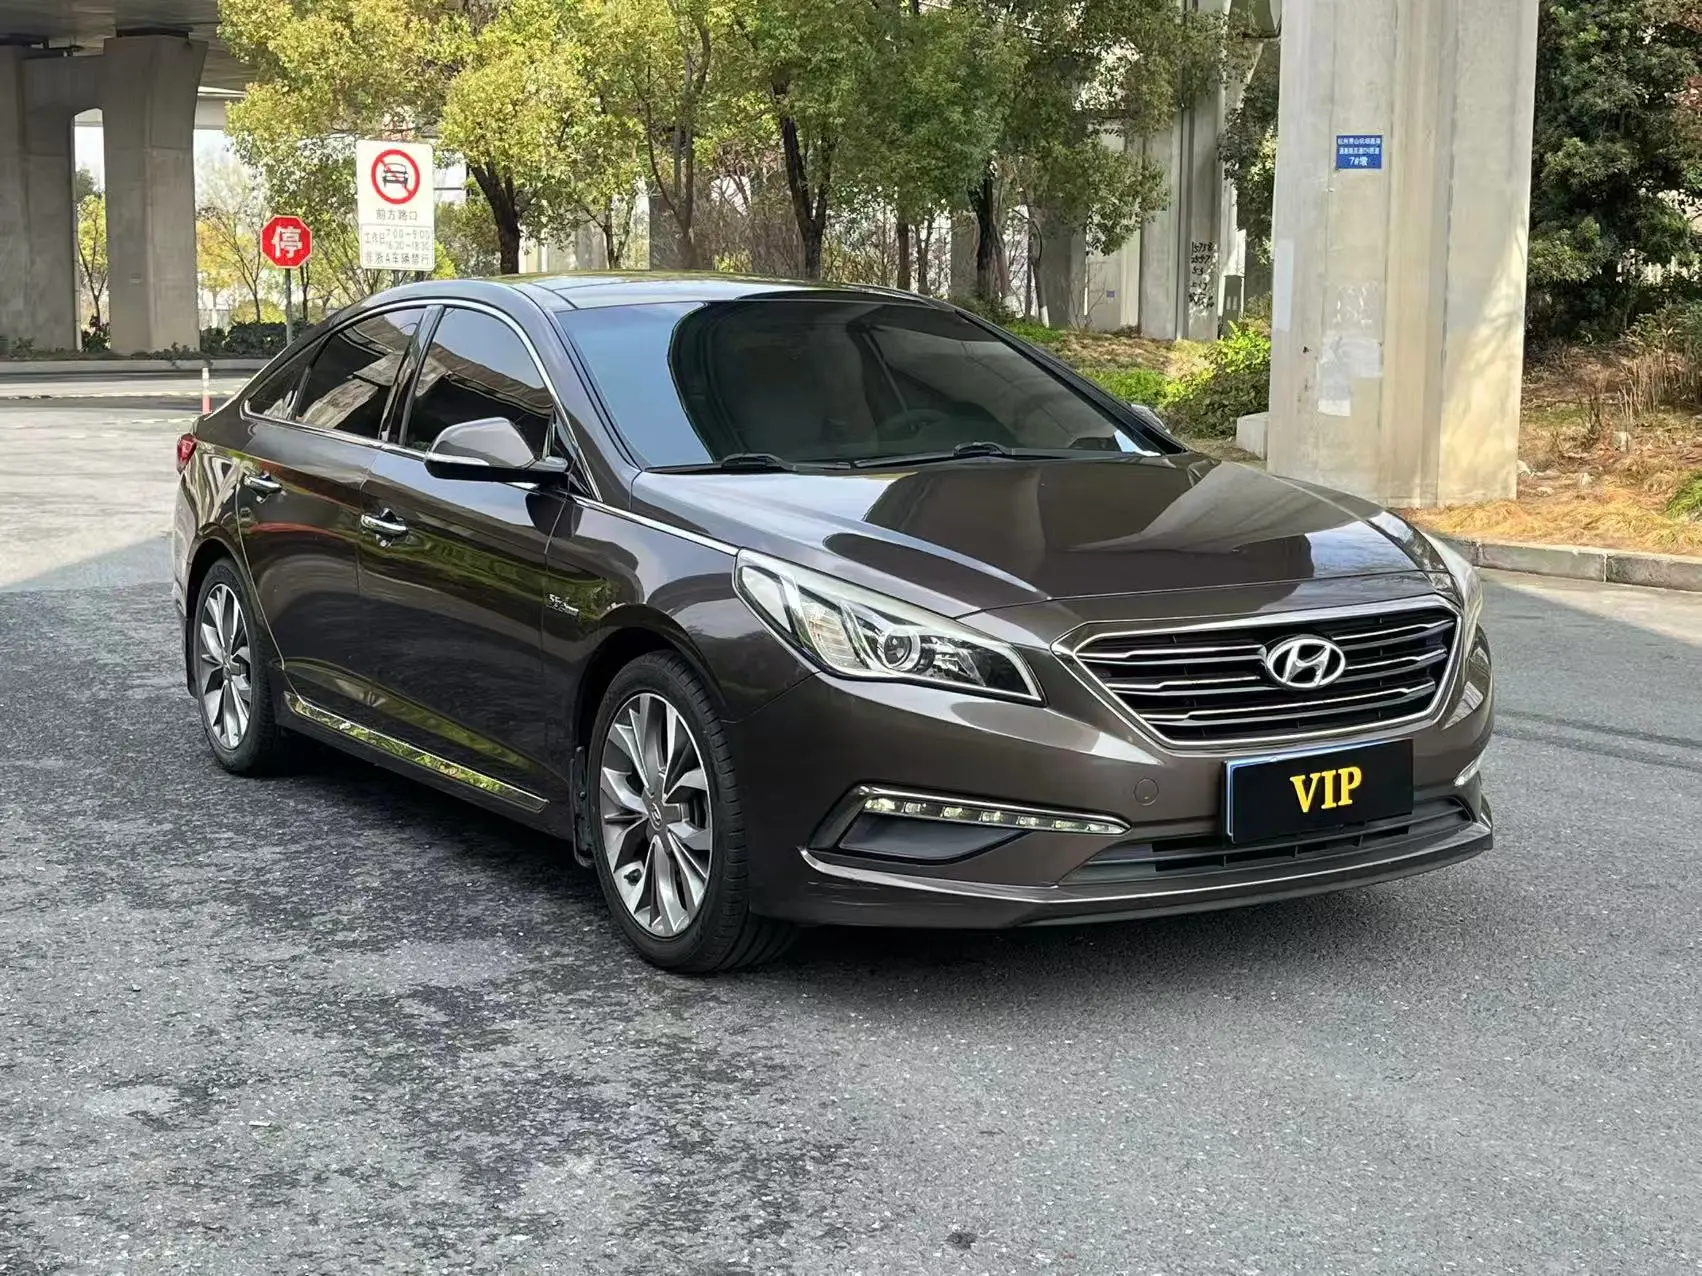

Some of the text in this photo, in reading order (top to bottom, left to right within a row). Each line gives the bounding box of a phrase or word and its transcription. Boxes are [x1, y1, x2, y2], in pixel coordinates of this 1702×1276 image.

[375, 208, 418, 221] 前方路口
[271, 225, 303, 259] 停
[1290, 765, 1362, 813] VIP
